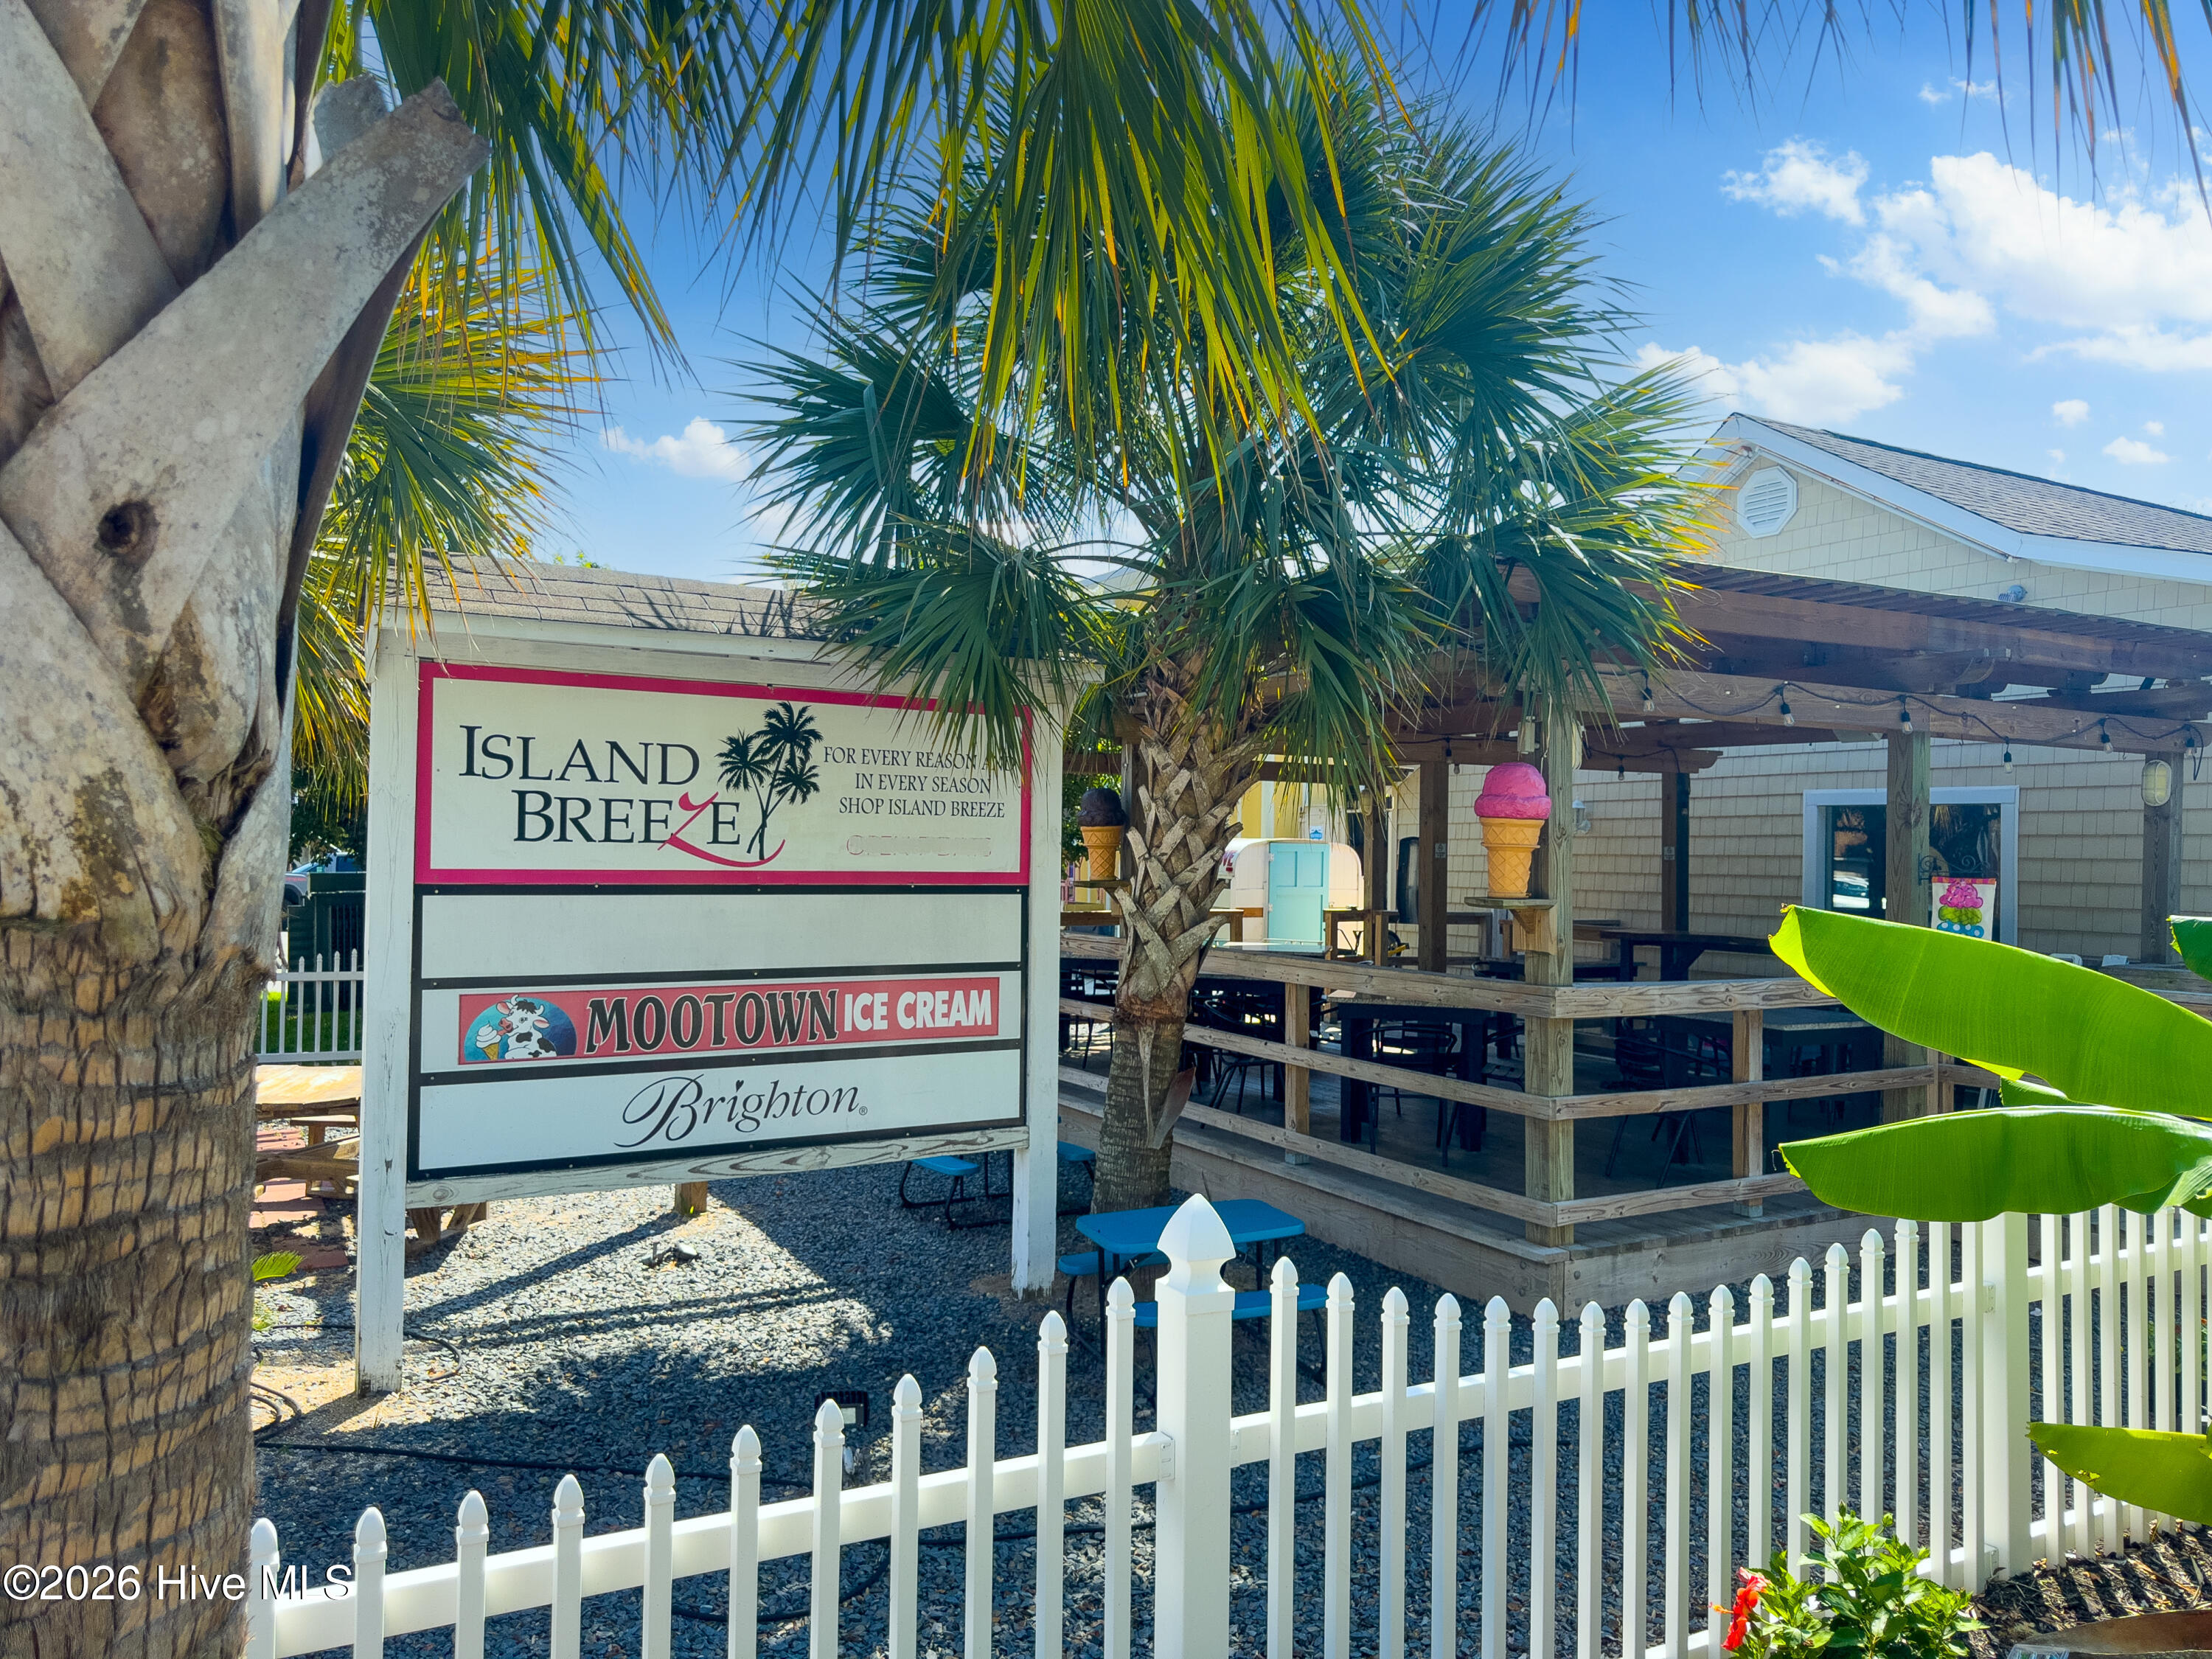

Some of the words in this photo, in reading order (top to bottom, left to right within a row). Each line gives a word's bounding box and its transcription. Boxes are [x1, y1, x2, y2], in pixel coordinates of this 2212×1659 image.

[458, 724, 700, 786] ISLAND
[824, 746, 857, 764] FOR
[861, 748, 911, 767] EVERY
[916, 751, 977, 769] REASON
[855, 772, 873, 790] IN
[878, 773, 927, 791] EVERY
[931, 776, 991, 793] SEASON
[839, 796, 885, 815] SHOP
[888, 799, 947, 817] ISLAND
[950, 801, 1005, 818] BREEZE
[511, 789, 786, 868] BREEZE
[585, 988, 839, 1055] MOOTOWN
[844, 992, 889, 1032] ICE
[896, 989, 992, 1030] CREAM
